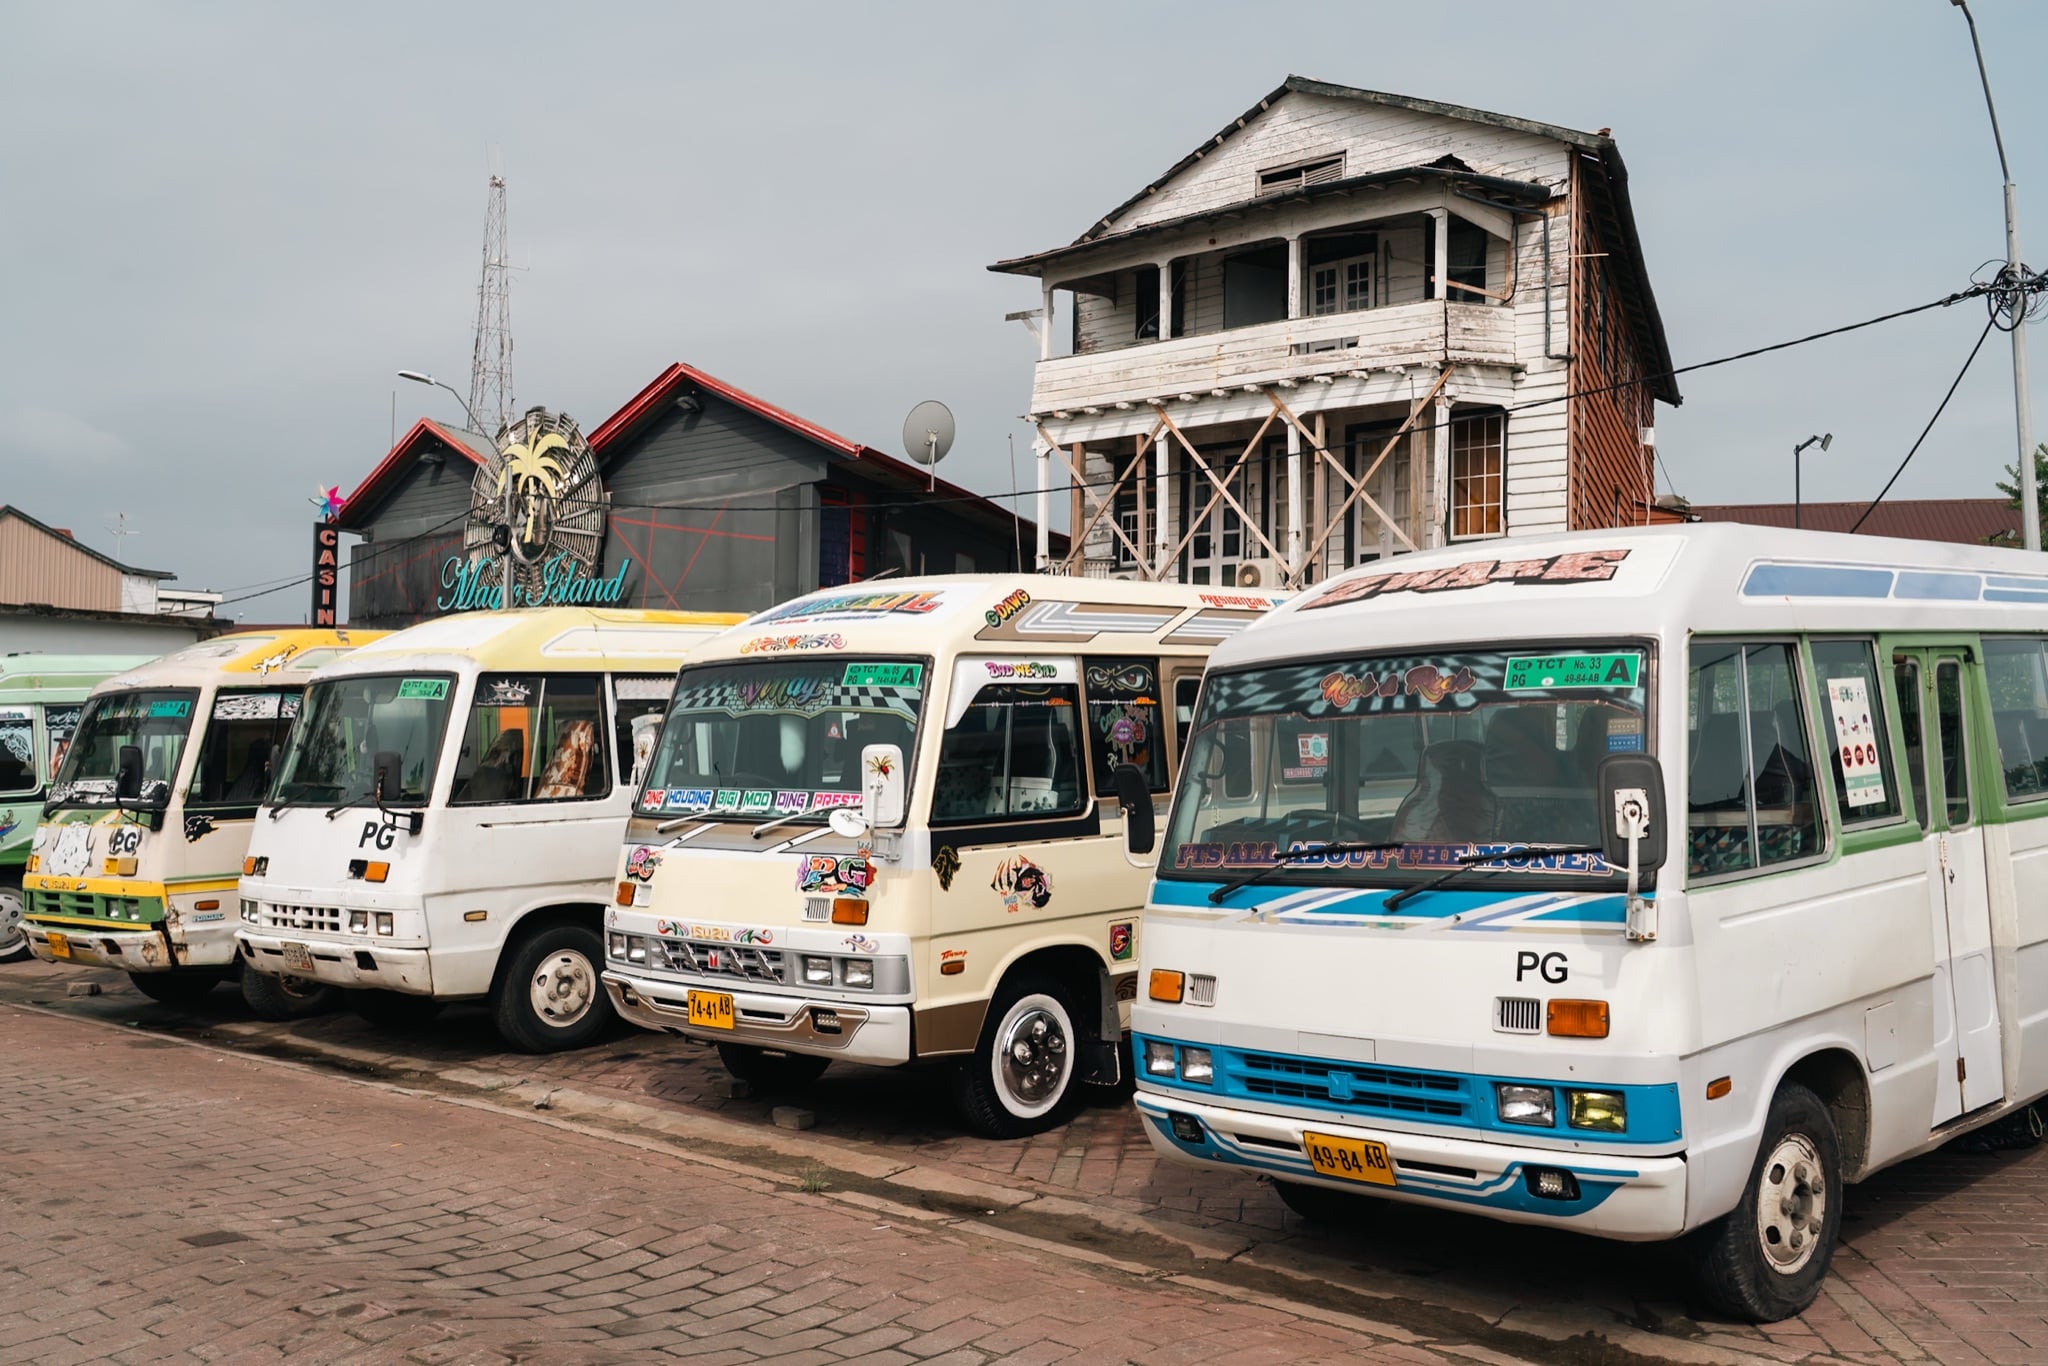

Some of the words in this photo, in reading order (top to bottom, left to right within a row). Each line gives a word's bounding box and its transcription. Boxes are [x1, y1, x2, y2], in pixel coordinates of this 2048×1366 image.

[317, 529, 336, 625] CASIN
[525, 551, 630, 607] Island
[1537, 658, 1567, 670] TCT
[1574, 659, 1586, 669] No.
[1590, 657, 1601, 670] 33
[1604, 658, 1631, 682] A
[900, 667, 916, 686] A
[1511, 673, 1526, 687] PG
[1563, 673, 1600, 683] 49-84-AB
[432, 682, 443, 696] A
[176, 702, 187, 716] A
[776, 792, 806, 811] DING
[112, 828, 137, 852] PG
[359, 821, 397, 850] PG
[1224, 842, 1279, 868] ALL
[1283, 841, 1391, 868] ABOUT
[1393, 842, 1470, 870] THE
[1472, 842, 1612, 877] MONEY
[803, 857, 867, 891] PG
[691, 926, 730, 941] ISUZU
[1516, 951, 1568, 984] PG
[690, 998, 717, 1020] 74-41
[719, 996, 731, 1015] AB
[1313, 1145, 1363, 1173] 49-84
[1364, 1143, 1386, 1169] AB
